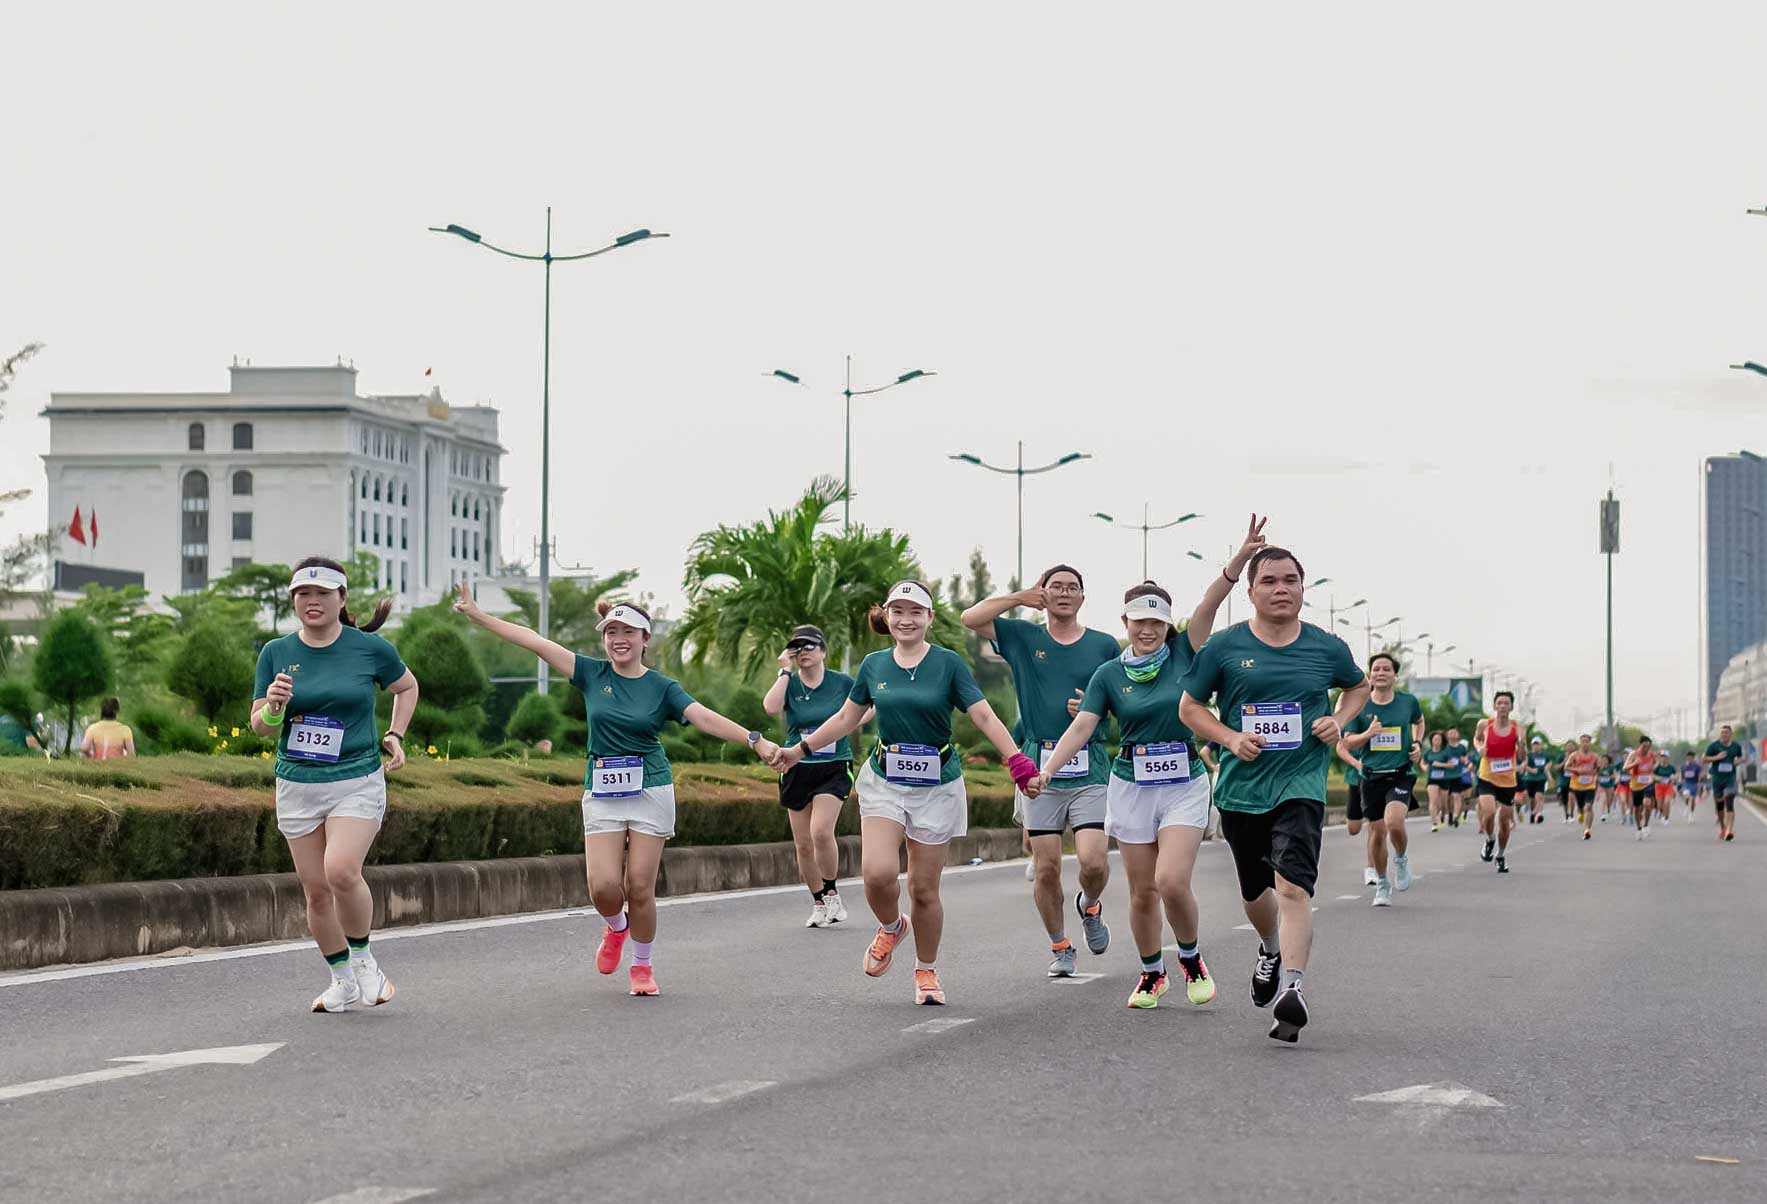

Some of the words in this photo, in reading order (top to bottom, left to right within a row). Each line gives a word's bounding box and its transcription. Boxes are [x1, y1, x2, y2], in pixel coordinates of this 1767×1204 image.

[1254, 722, 1290, 735] 5884
[296, 731, 331, 746] 5132
[897, 759, 929, 772] 5567
[1145, 760, 1178, 773] 5565
[602, 772, 631, 785] 5311
